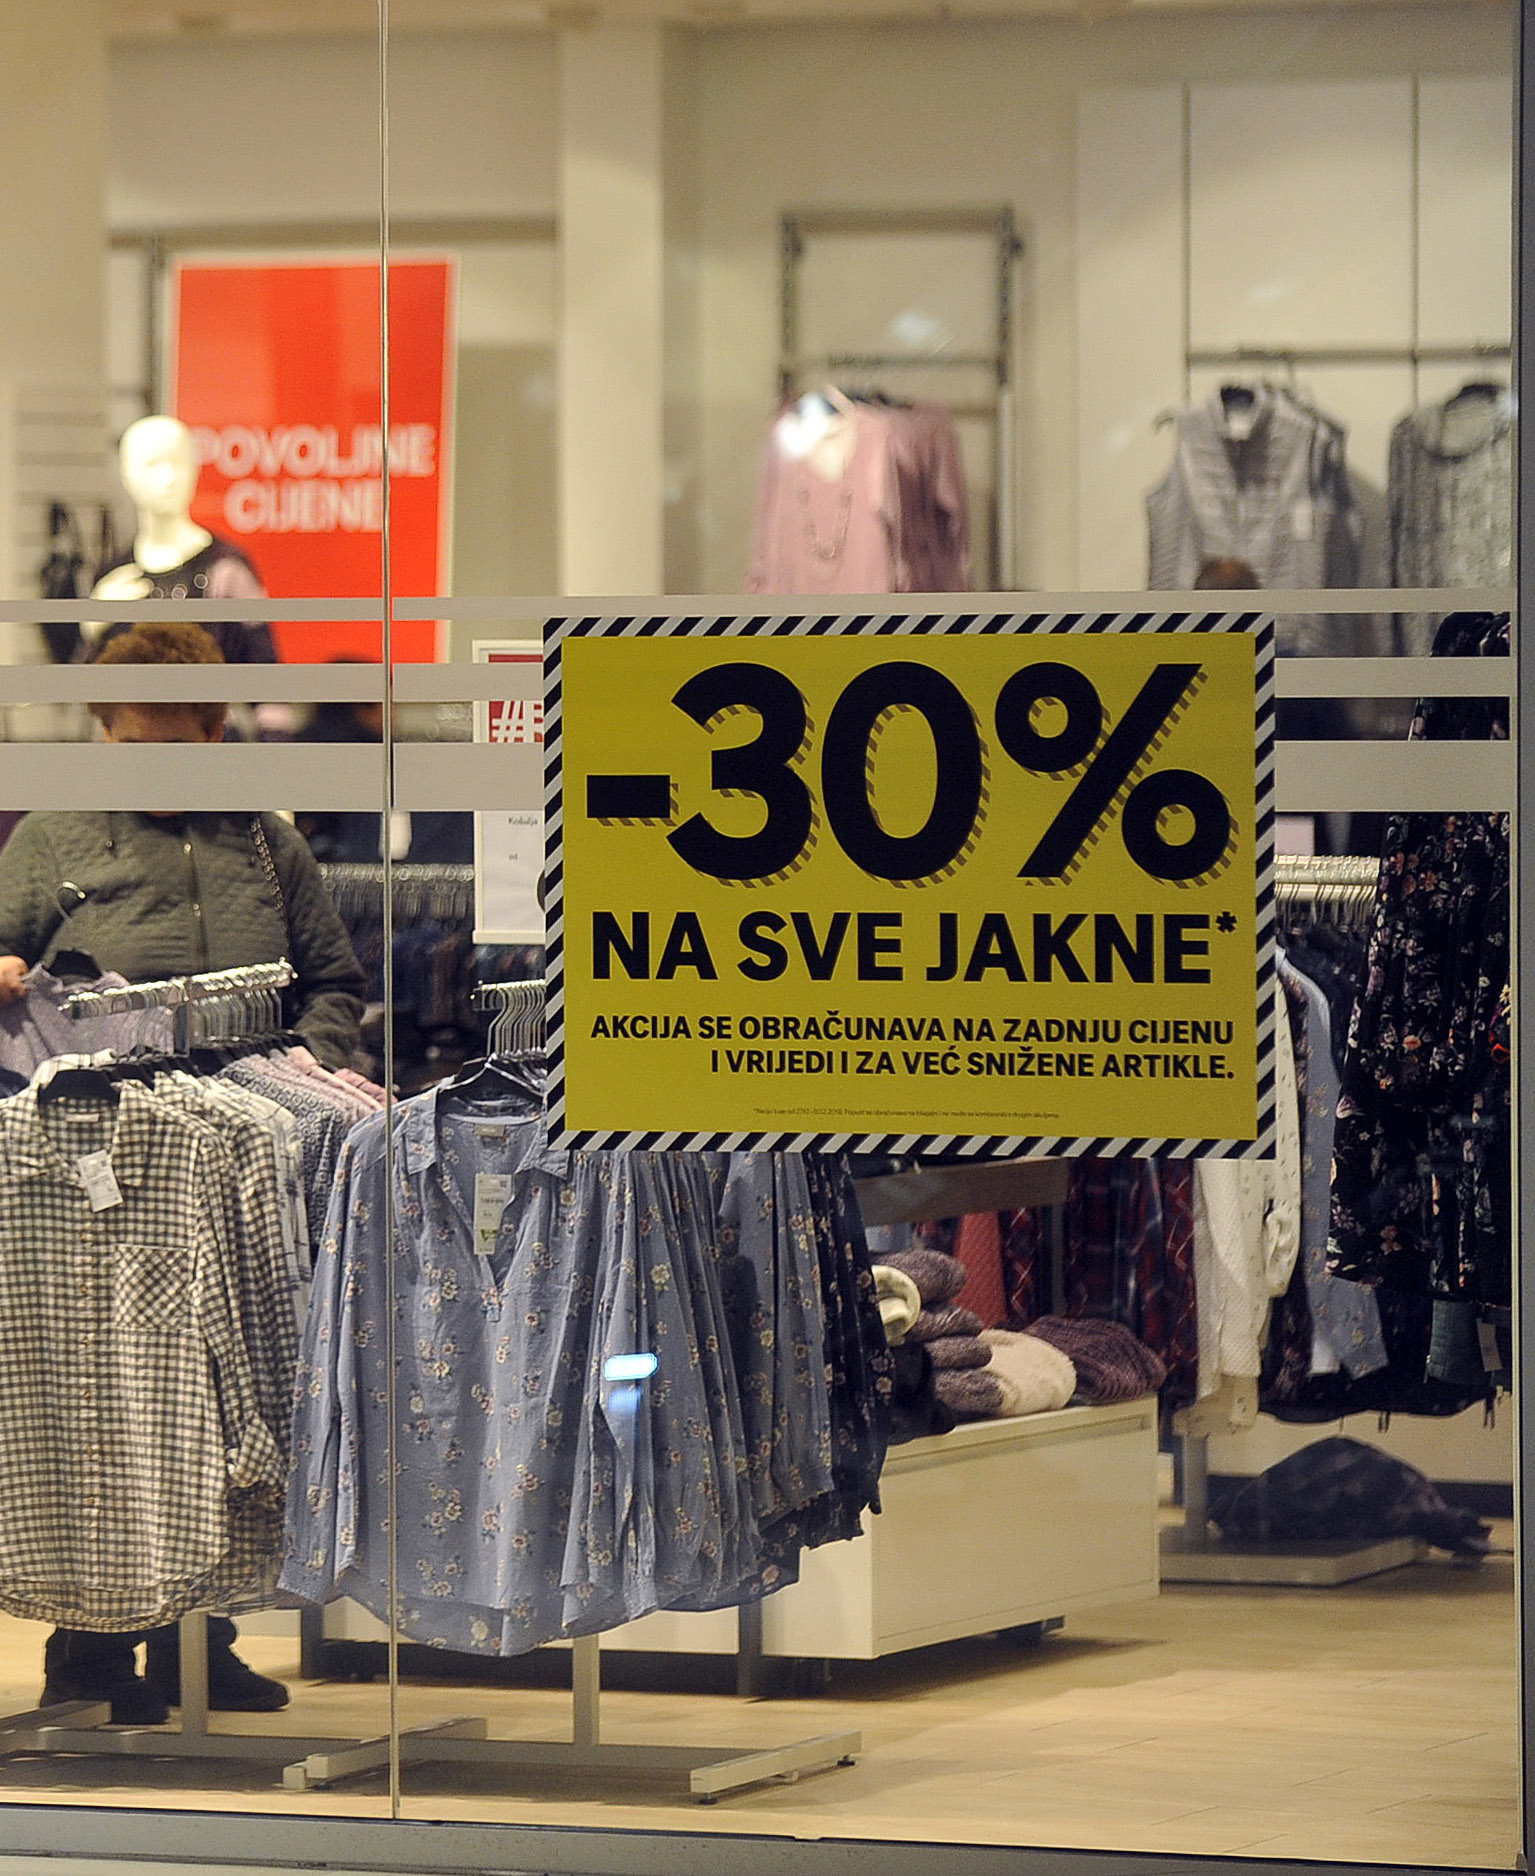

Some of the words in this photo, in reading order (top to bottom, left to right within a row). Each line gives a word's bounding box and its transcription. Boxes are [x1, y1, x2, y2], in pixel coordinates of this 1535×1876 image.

[190, 423, 436, 479] POVOLJNE
[587, 661, 1236, 886] -30%
[592, 911, 719, 980] NA
[737, 911, 904, 981] SVE
[591, 1015, 692, 1039] AKCIJA
[698, 1016, 732, 1040] SE
[739, 1010, 946, 1042] OBRAČUNAVA
[954, 1018, 996, 1042] NA
[1003, 1018, 1121, 1043] ZADNJU
[1129, 1020, 1233, 1044] CIJENU
[711, 1050, 719, 1073] I
[726, 1050, 834, 1074] VRIJEDI
[841, 1051, 848, 1074] I
[856, 1051, 896, 1075] ZA
[902, 1045, 961, 1076] VEĆ
[967, 1046, 1094, 1077] SNIŽENE
[1101, 1054, 1234, 1079] ARTIKLE.
